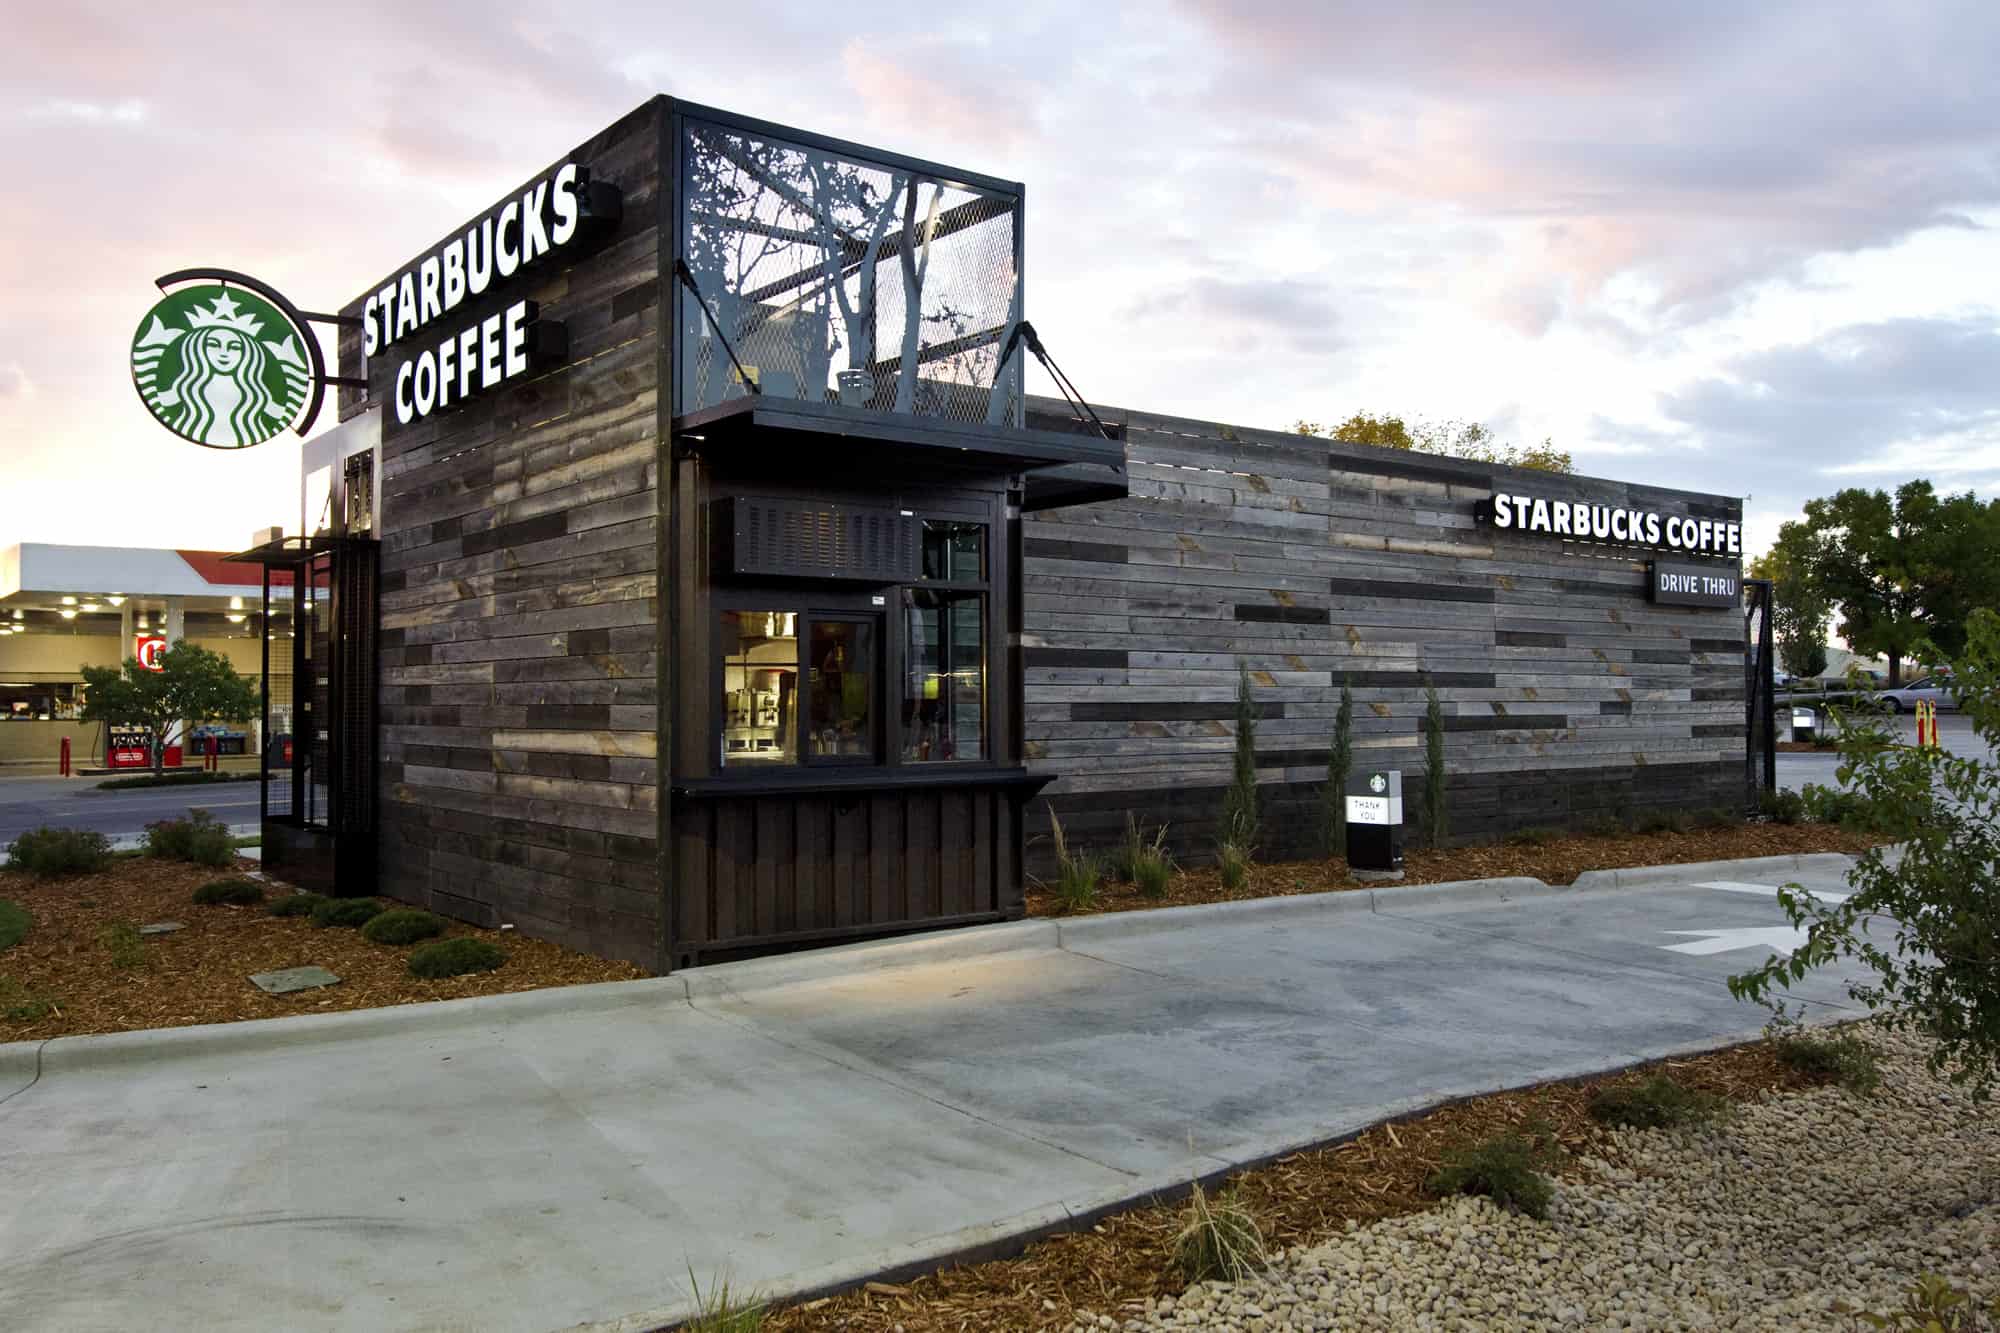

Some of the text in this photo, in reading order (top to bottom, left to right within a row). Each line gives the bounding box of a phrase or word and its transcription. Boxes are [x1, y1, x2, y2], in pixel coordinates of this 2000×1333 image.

[363, 163, 577, 358] STARBUCKS
[396, 300, 528, 424] COFFEE
[1493, 493, 1661, 545] STARBUCKS
[1660, 573, 1736, 596] DRIVE THRU
[1360, 811, 1376, 820] YOU
